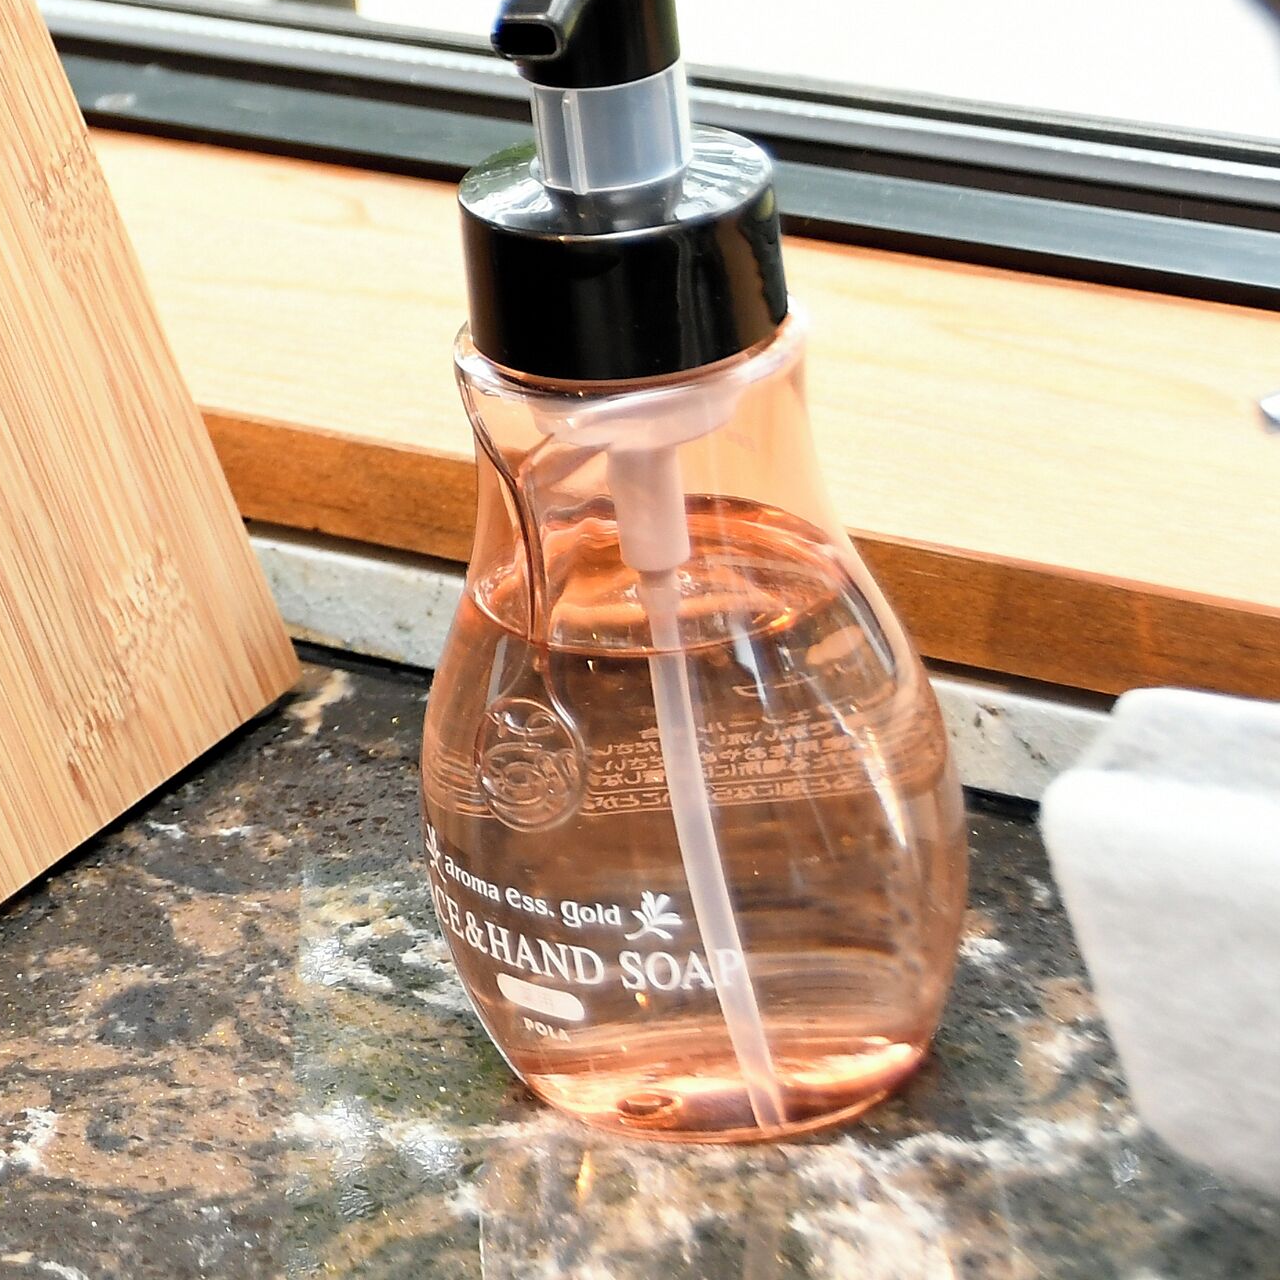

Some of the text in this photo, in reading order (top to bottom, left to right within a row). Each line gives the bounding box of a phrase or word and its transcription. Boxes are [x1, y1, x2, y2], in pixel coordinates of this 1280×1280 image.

[444, 855, 622, 928] aroma ess. gold
[618, 948, 741, 991] SOAP
